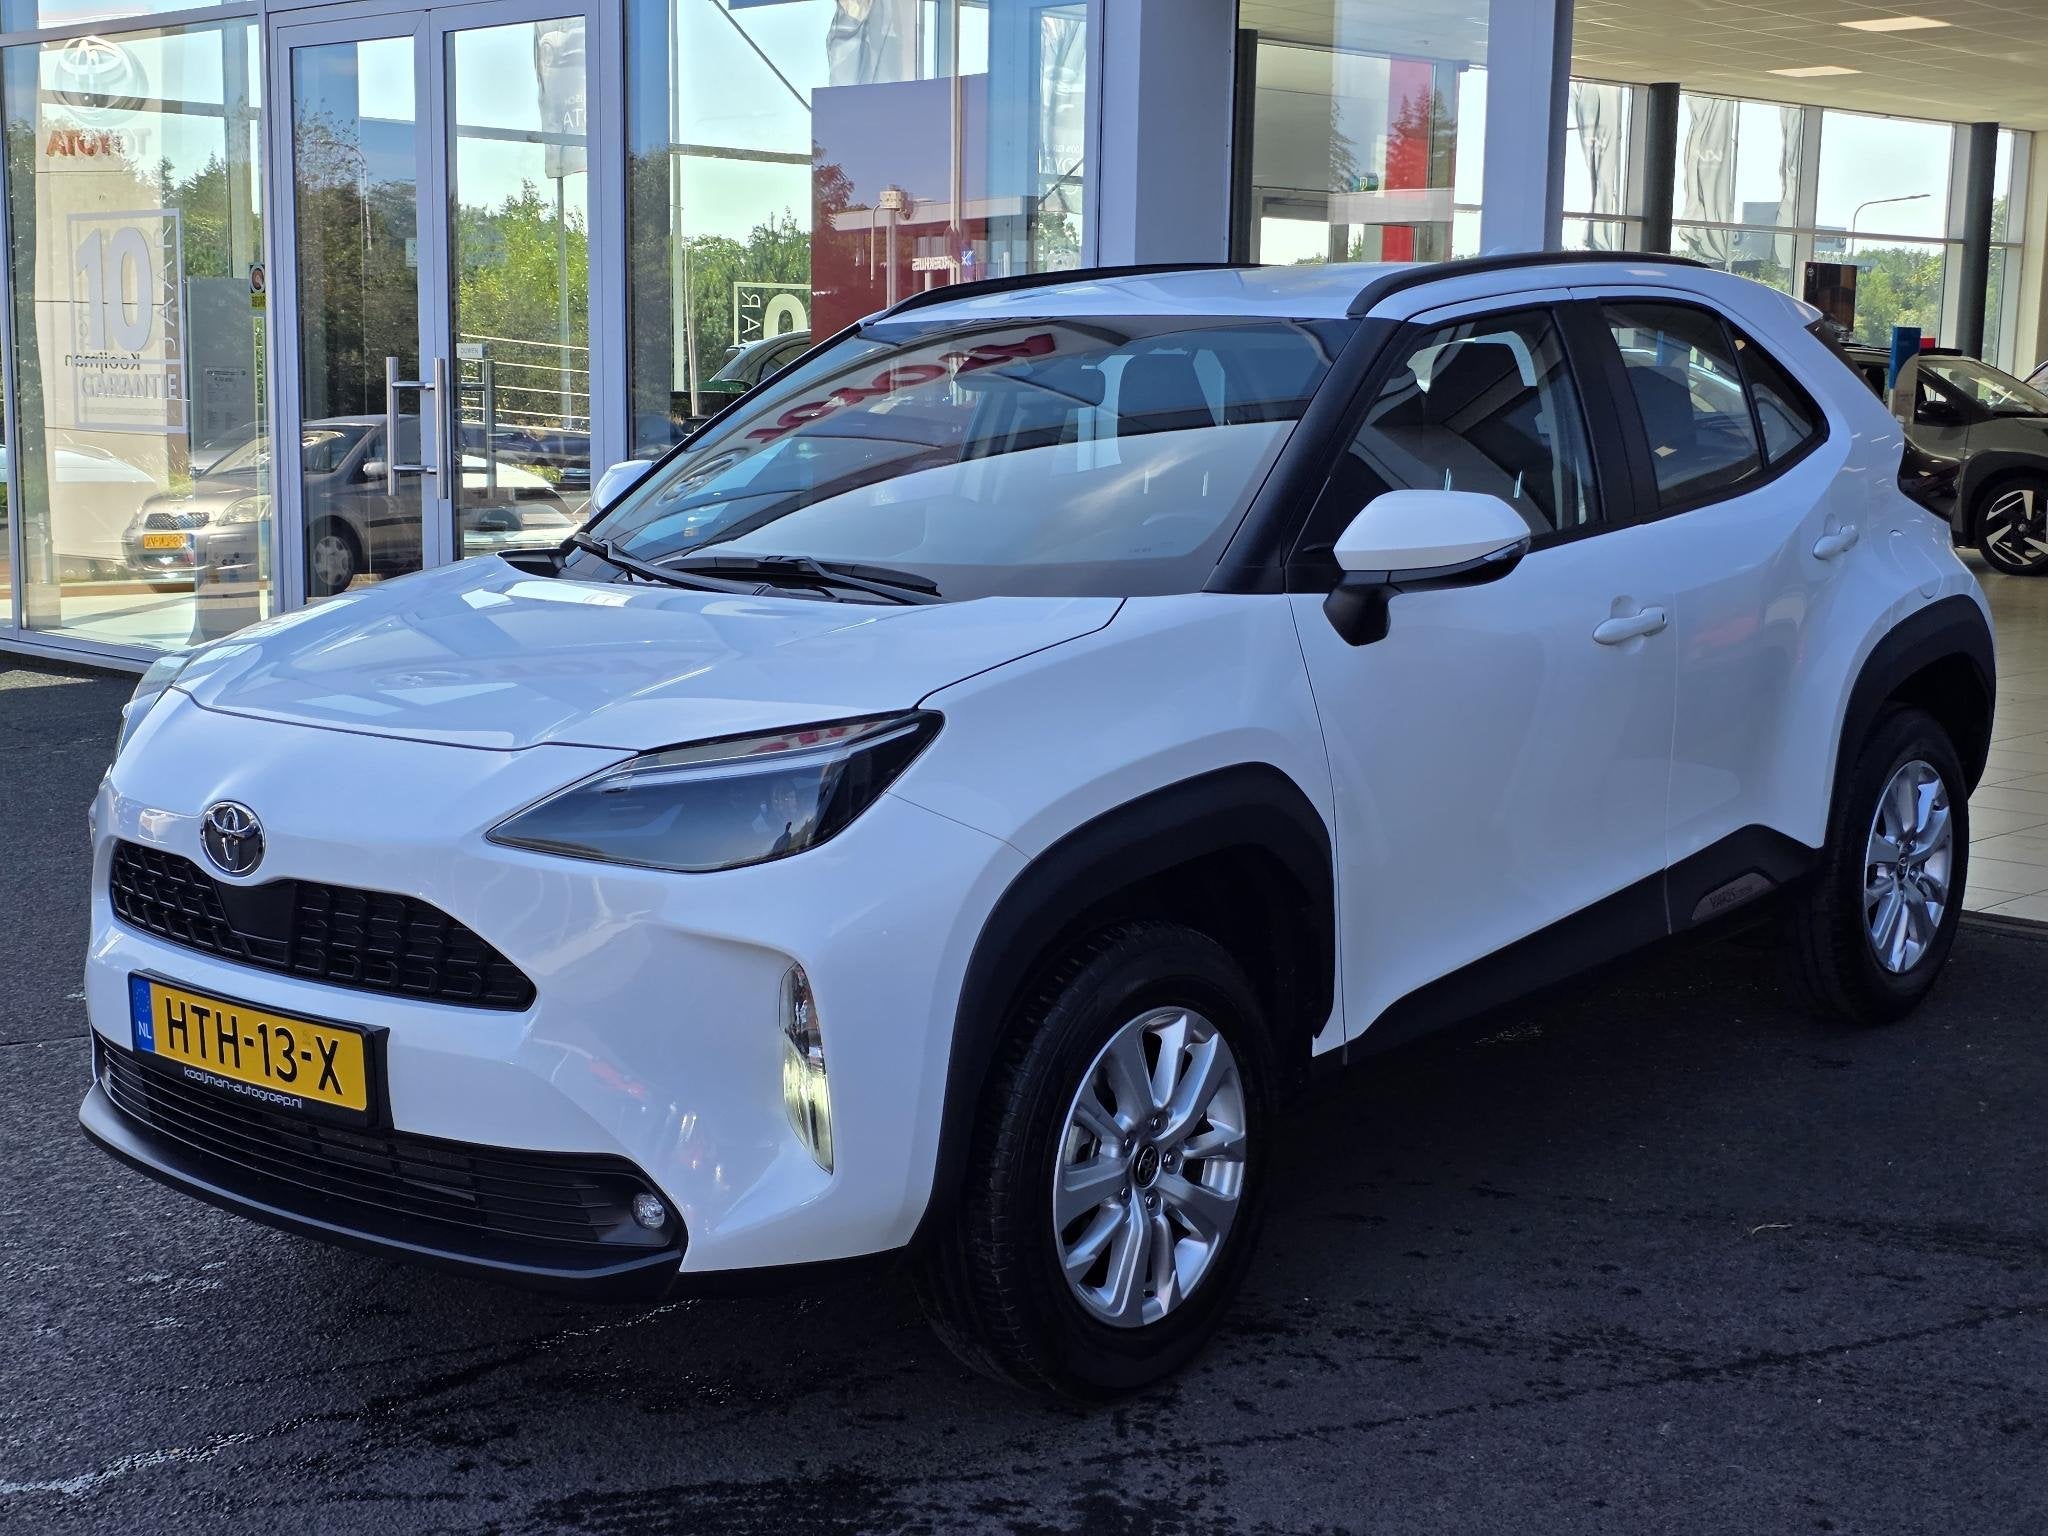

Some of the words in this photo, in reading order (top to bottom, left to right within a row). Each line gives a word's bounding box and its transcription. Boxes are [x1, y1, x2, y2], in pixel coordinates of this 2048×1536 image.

[75, 226, 154, 353] 10
[138, 1022, 153, 1040] NL
[165, 996, 344, 1096] HTH-13-X
[183, 1066, 303, 1109] kooijman-autogroep.nl
